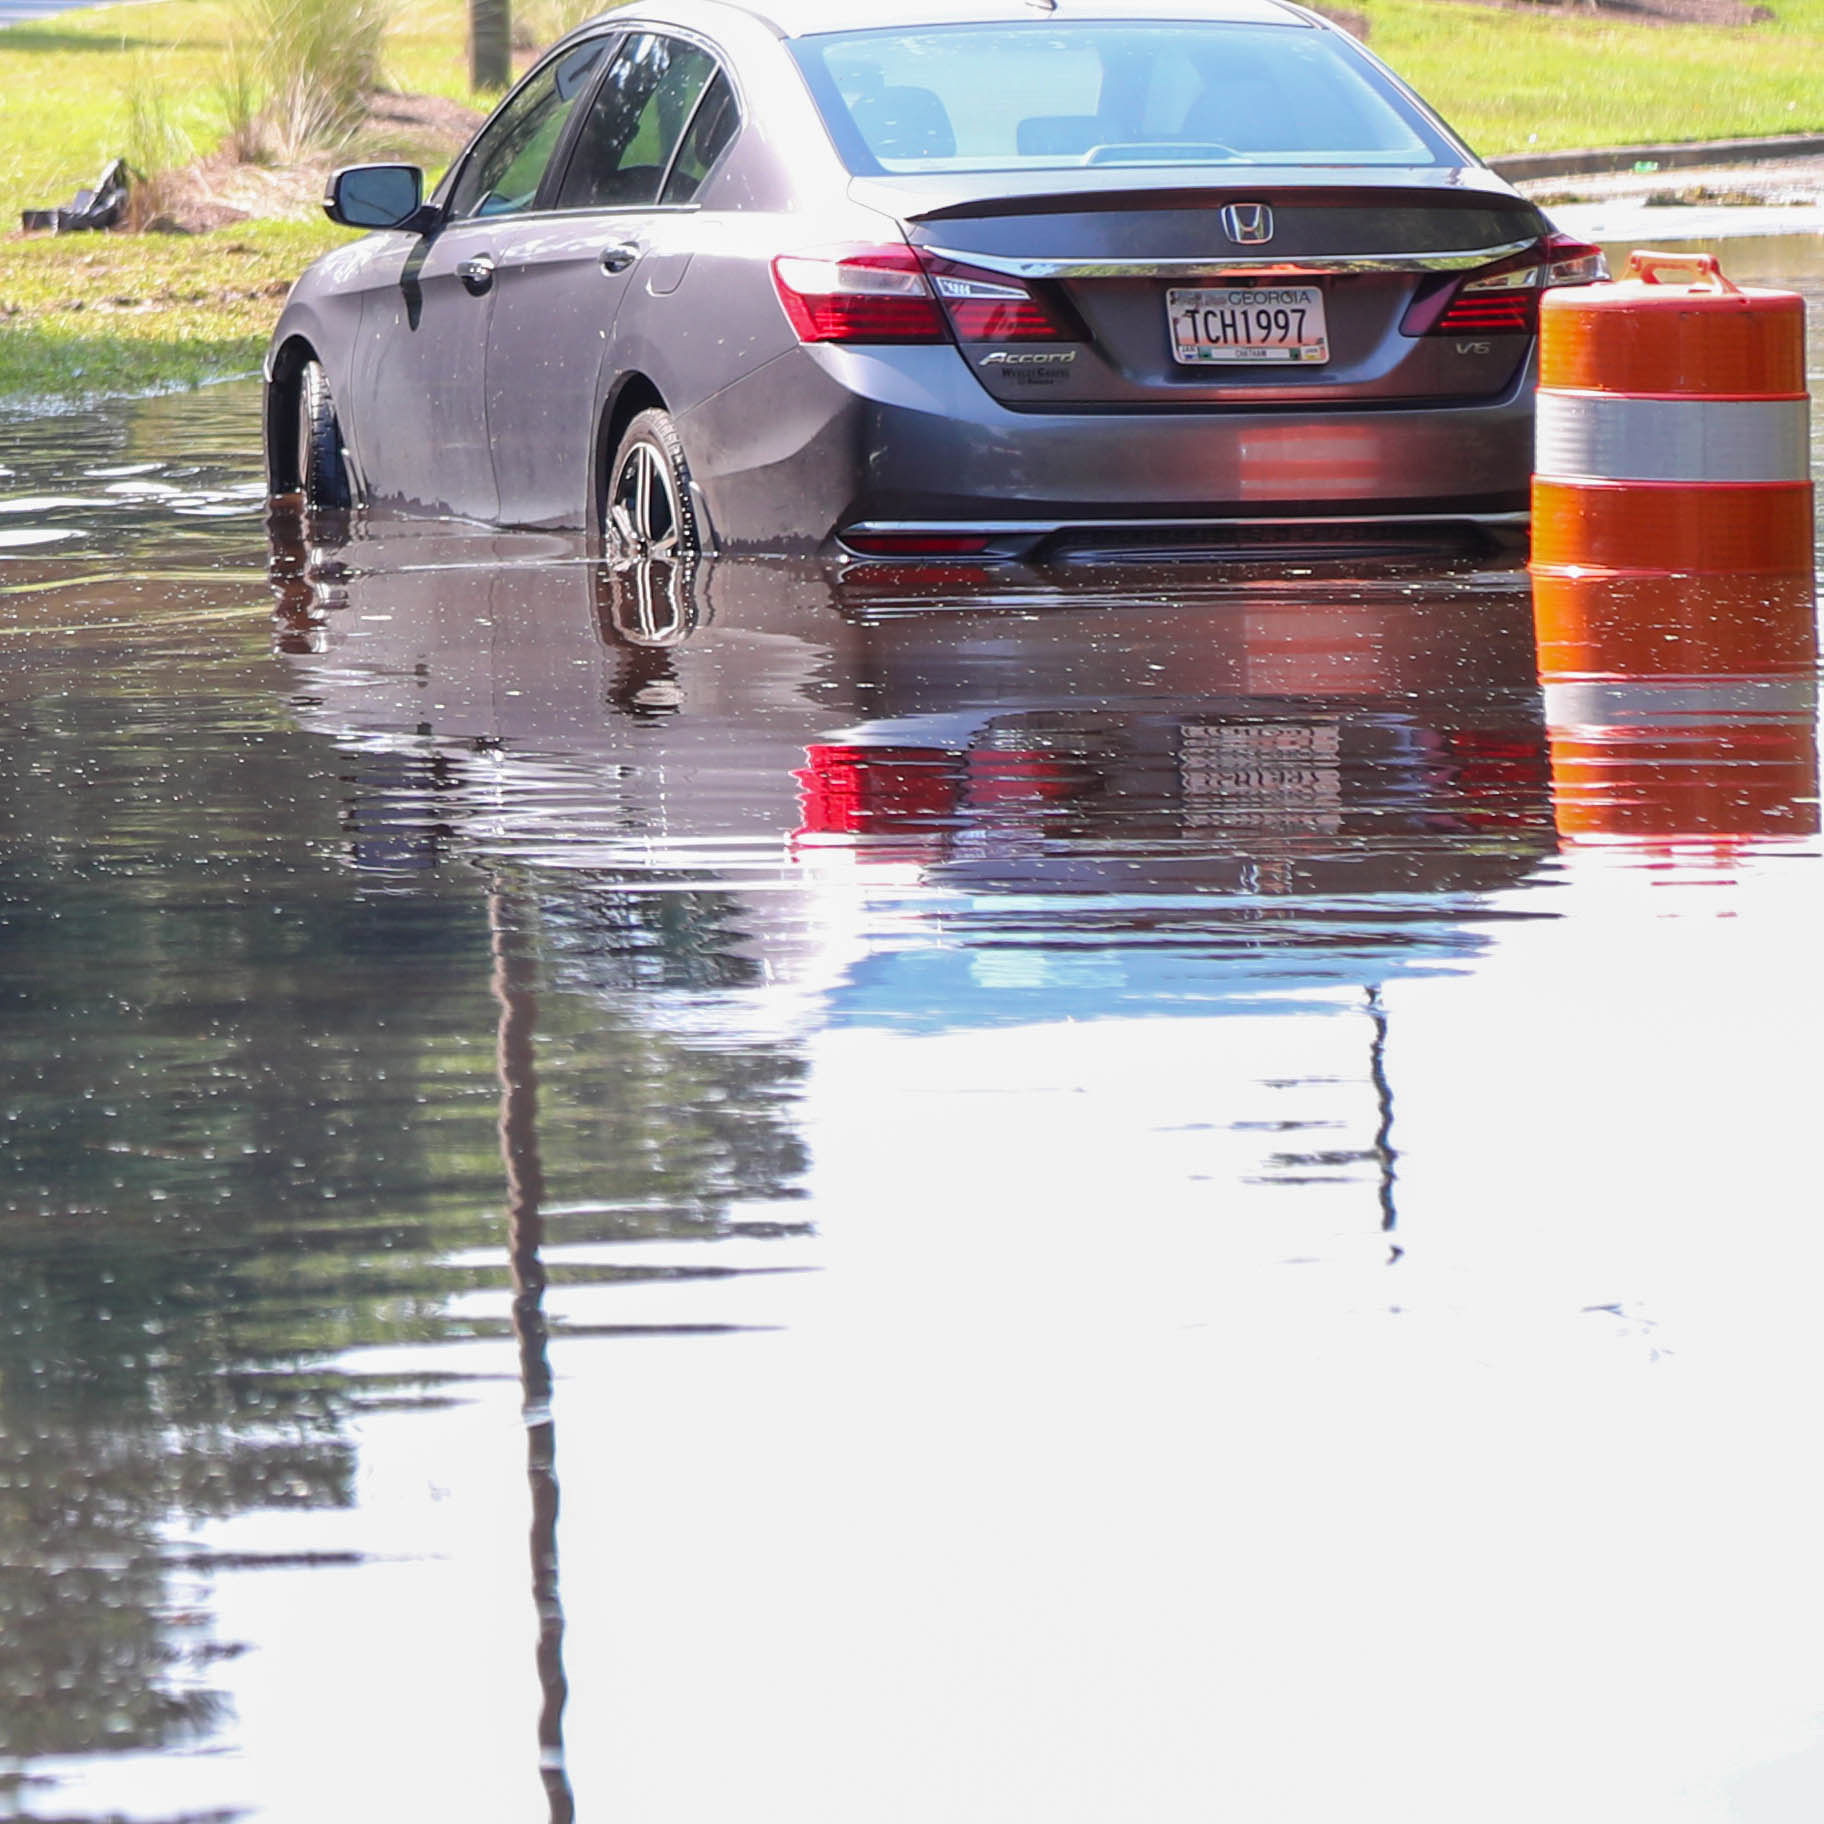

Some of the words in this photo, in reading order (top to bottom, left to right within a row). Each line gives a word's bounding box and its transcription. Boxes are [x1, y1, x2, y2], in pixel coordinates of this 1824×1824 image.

[1227, 291, 1312, 306] GEORGIA
[1184, 308, 1307, 345] TCH1997
[1455, 341, 1492, 354] V6
[978, 350, 1077, 366] Accord
